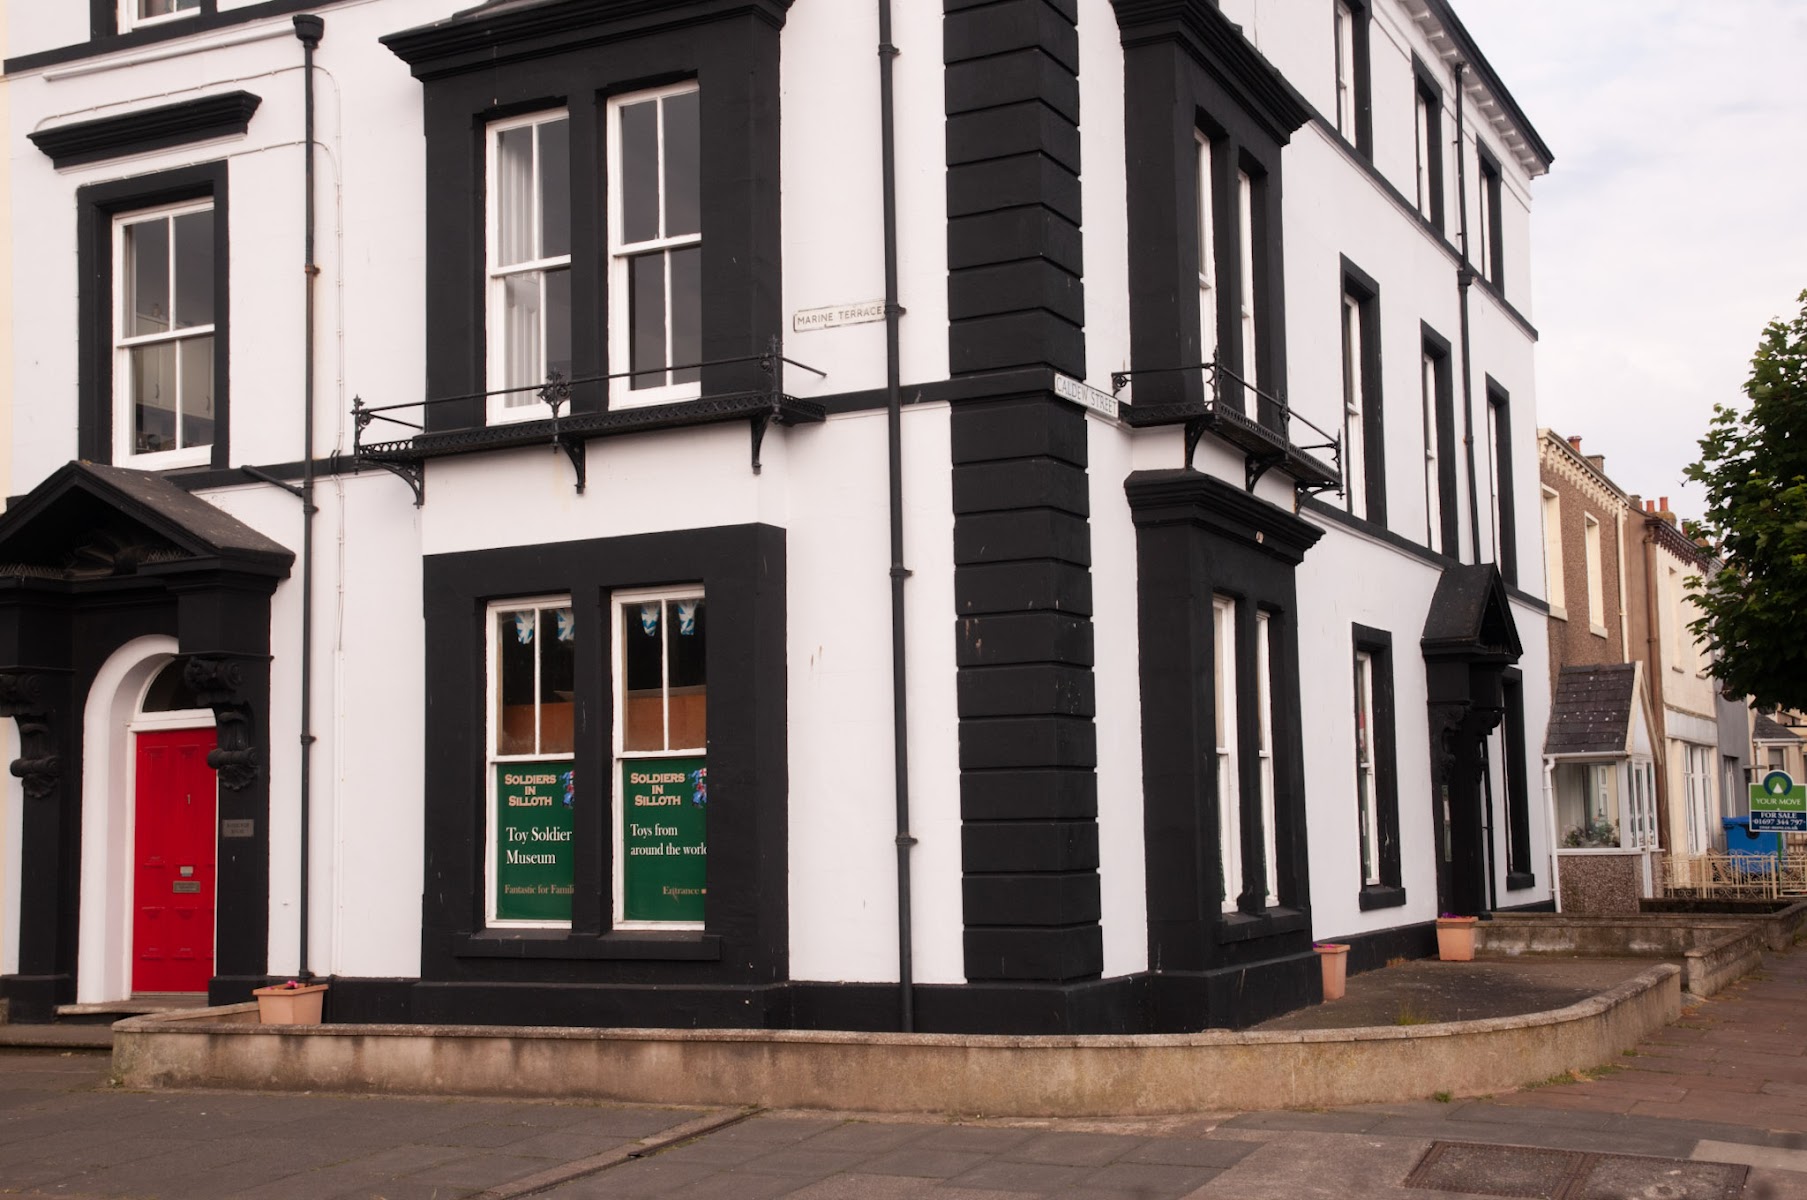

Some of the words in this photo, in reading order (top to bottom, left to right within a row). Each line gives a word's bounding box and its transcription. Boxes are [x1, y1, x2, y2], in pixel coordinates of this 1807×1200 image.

[797, 312, 834, 326] MARINE
[838, 305, 882, 320] TERRACE
[1056, 376, 1089, 401] CALDEW
[1090, 391, 1117, 415] STREET
[524, 785, 536, 796] IN
[651, 784, 664, 795] IN
[506, 827, 529, 845] Toy
[531, 826, 573, 842] Soldier
[629, 823, 653, 839] Toys
[654, 823, 678, 836] from
[630, 843, 664, 856] around
[665, 842, 681, 855] the
[506, 850, 556, 865] Museum
[504, 884, 536, 895] Fantastic
[537, 884, 550, 895] for
[662, 885, 700, 896] Entrance
